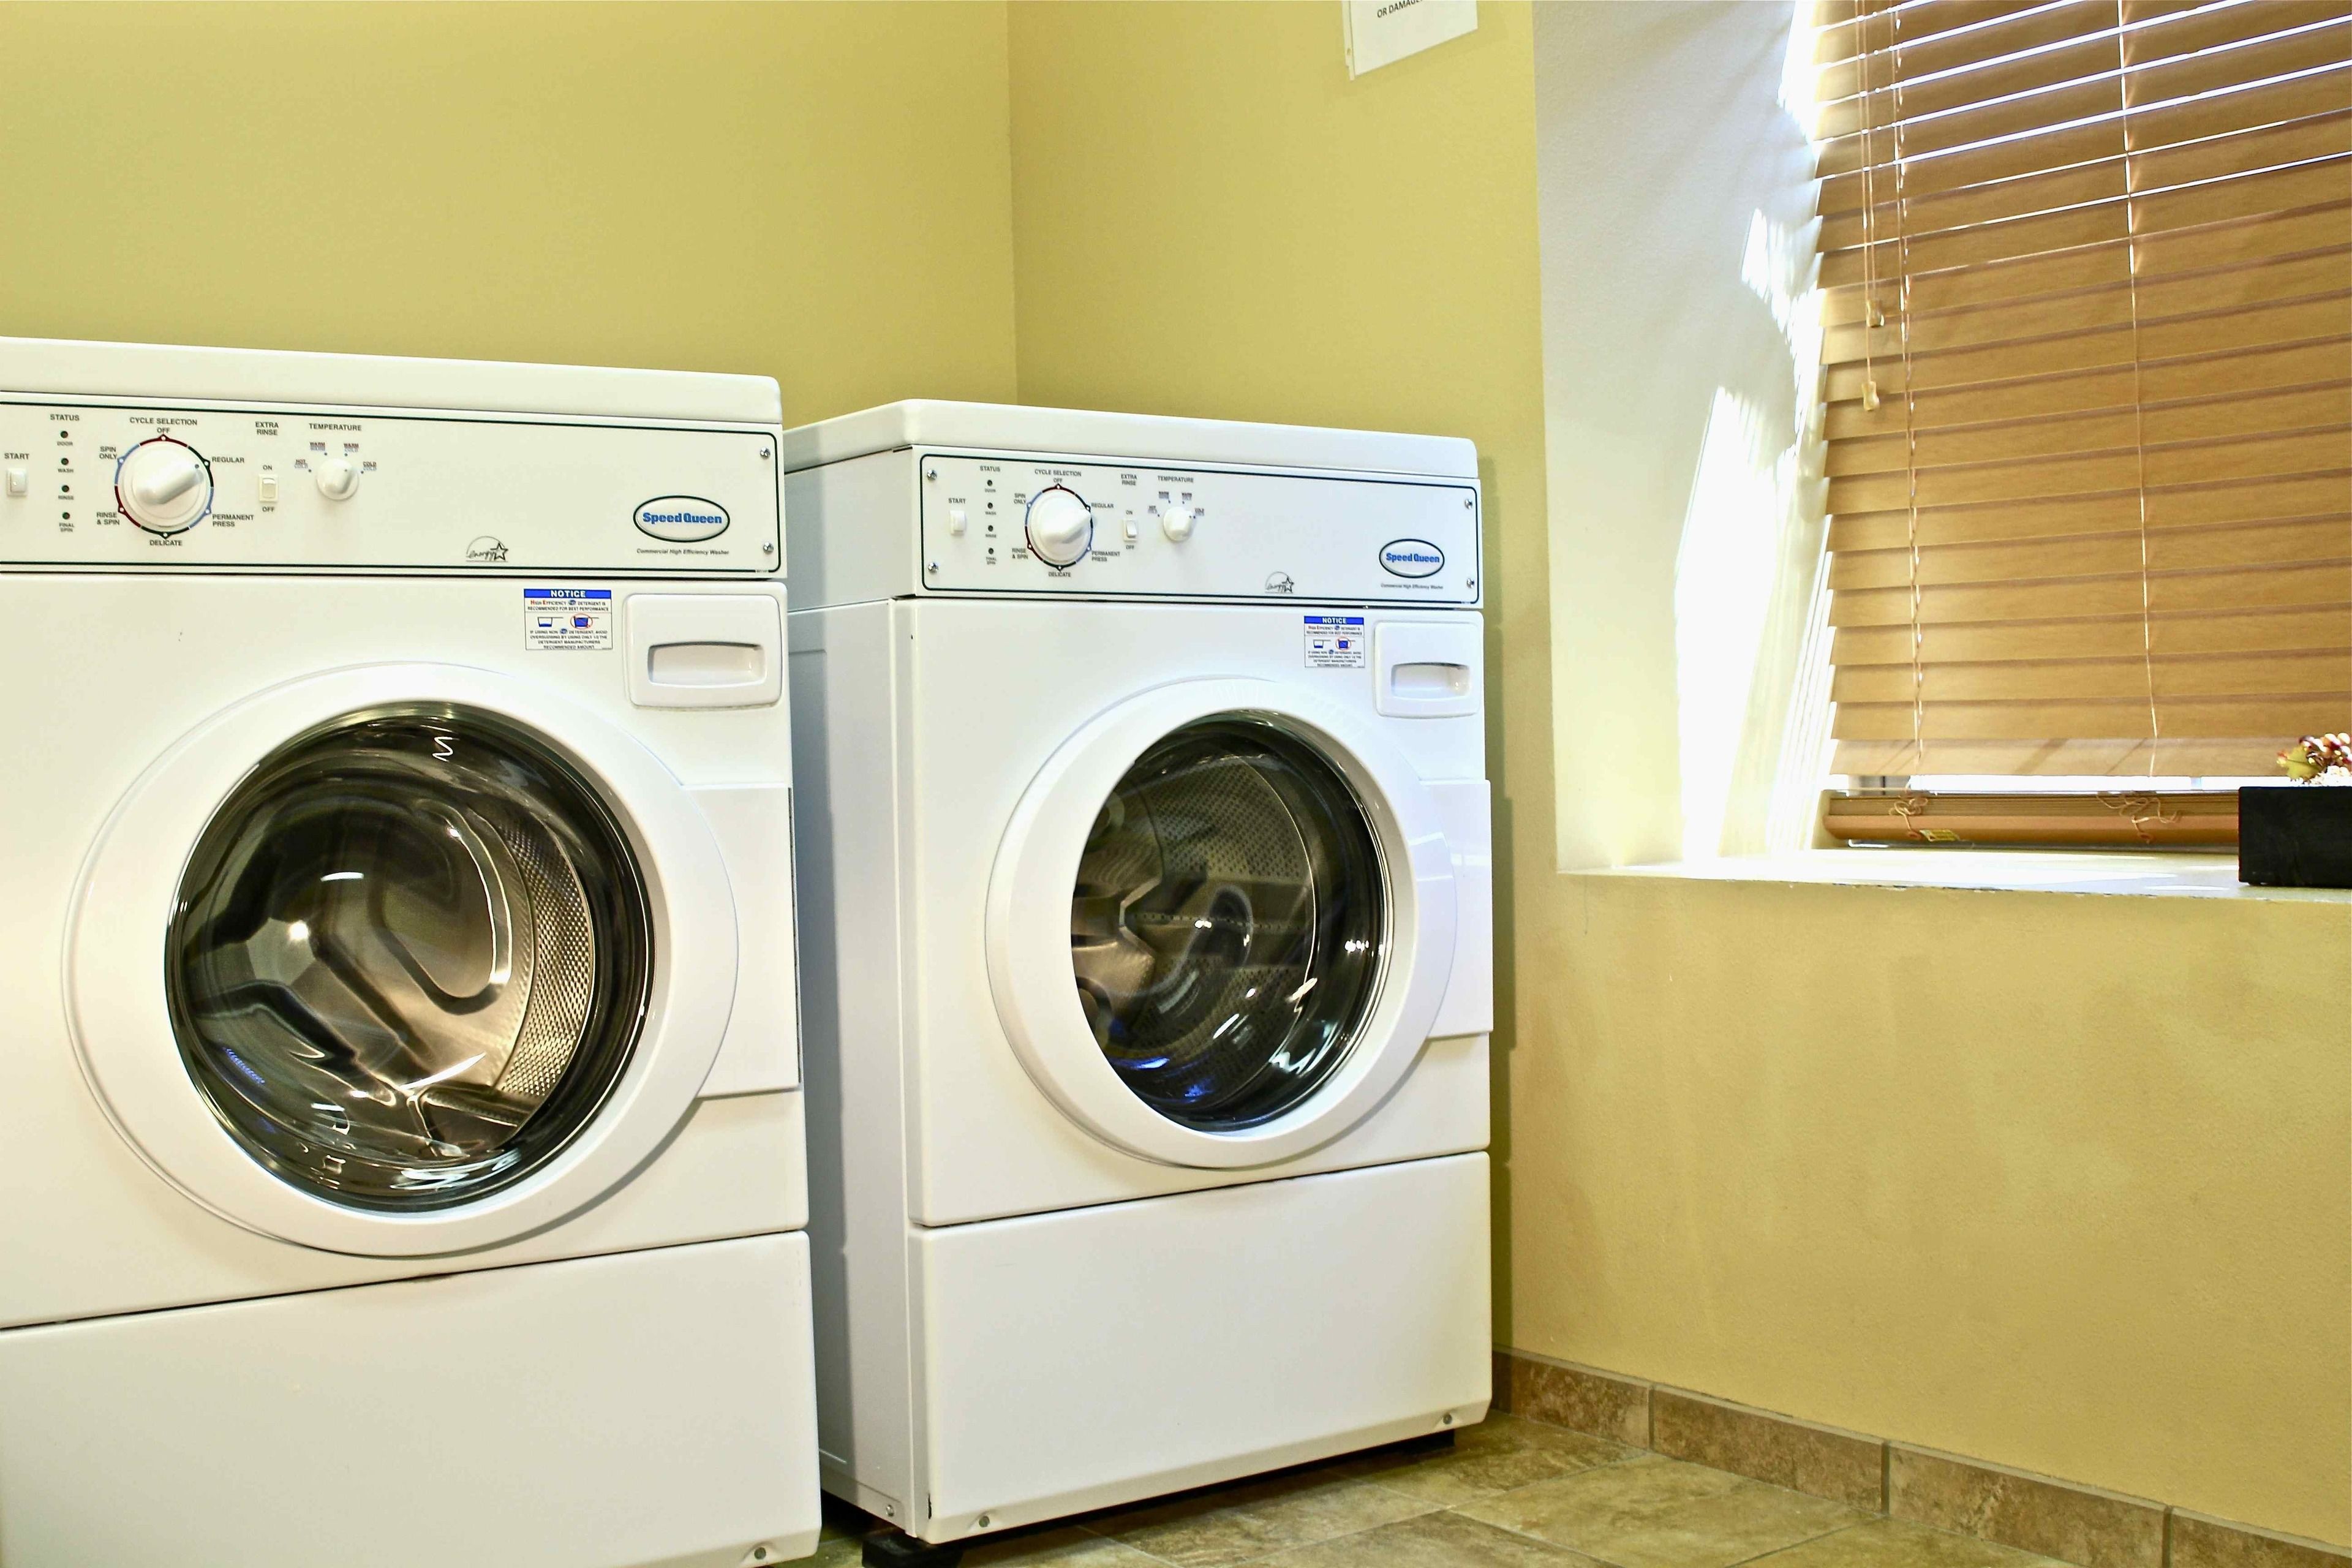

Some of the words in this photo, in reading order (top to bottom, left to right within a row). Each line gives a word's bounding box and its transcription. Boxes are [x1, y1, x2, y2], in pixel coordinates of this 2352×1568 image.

[1377, 8, 1387, 18] OR
[643, 513, 682, 524] Speed
[683, 513, 722, 524] Queen
[1385, 553, 1412, 563] Speed
[1414, 554, 1440, 563] Queen
